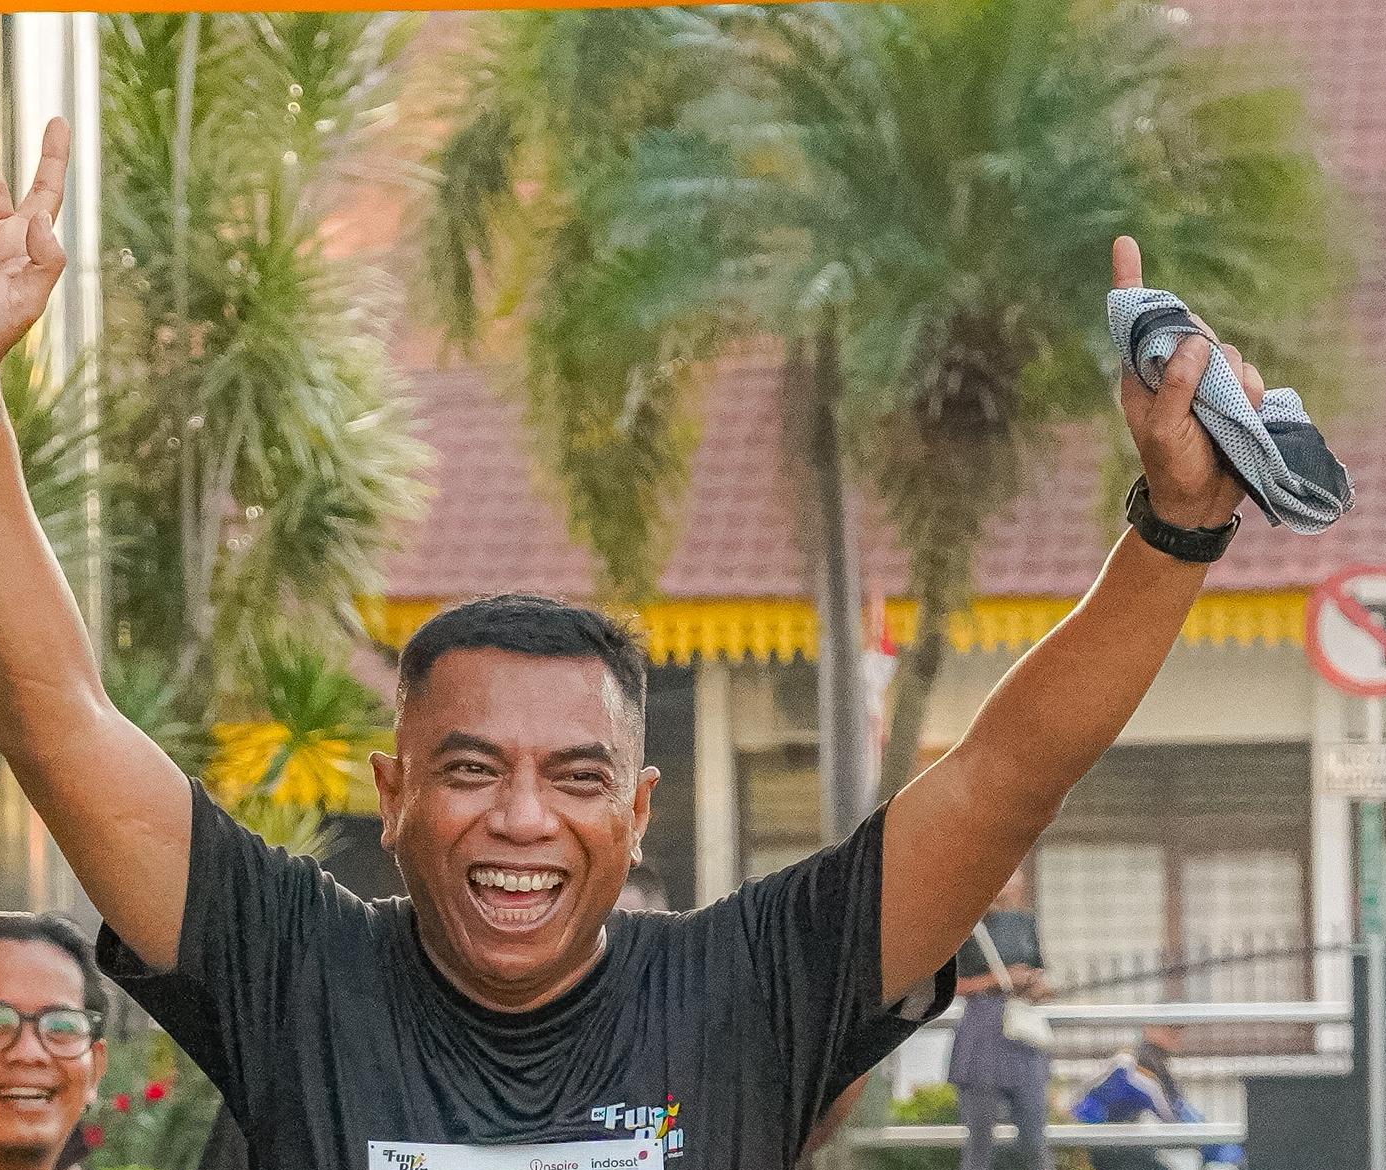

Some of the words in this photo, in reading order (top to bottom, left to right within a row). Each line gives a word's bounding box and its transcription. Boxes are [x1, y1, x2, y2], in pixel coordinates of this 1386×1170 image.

[604, 1102, 666, 1131] Fun
[387, 1149, 417, 1163] Fun
[591, 1157, 639, 1170] indosat
